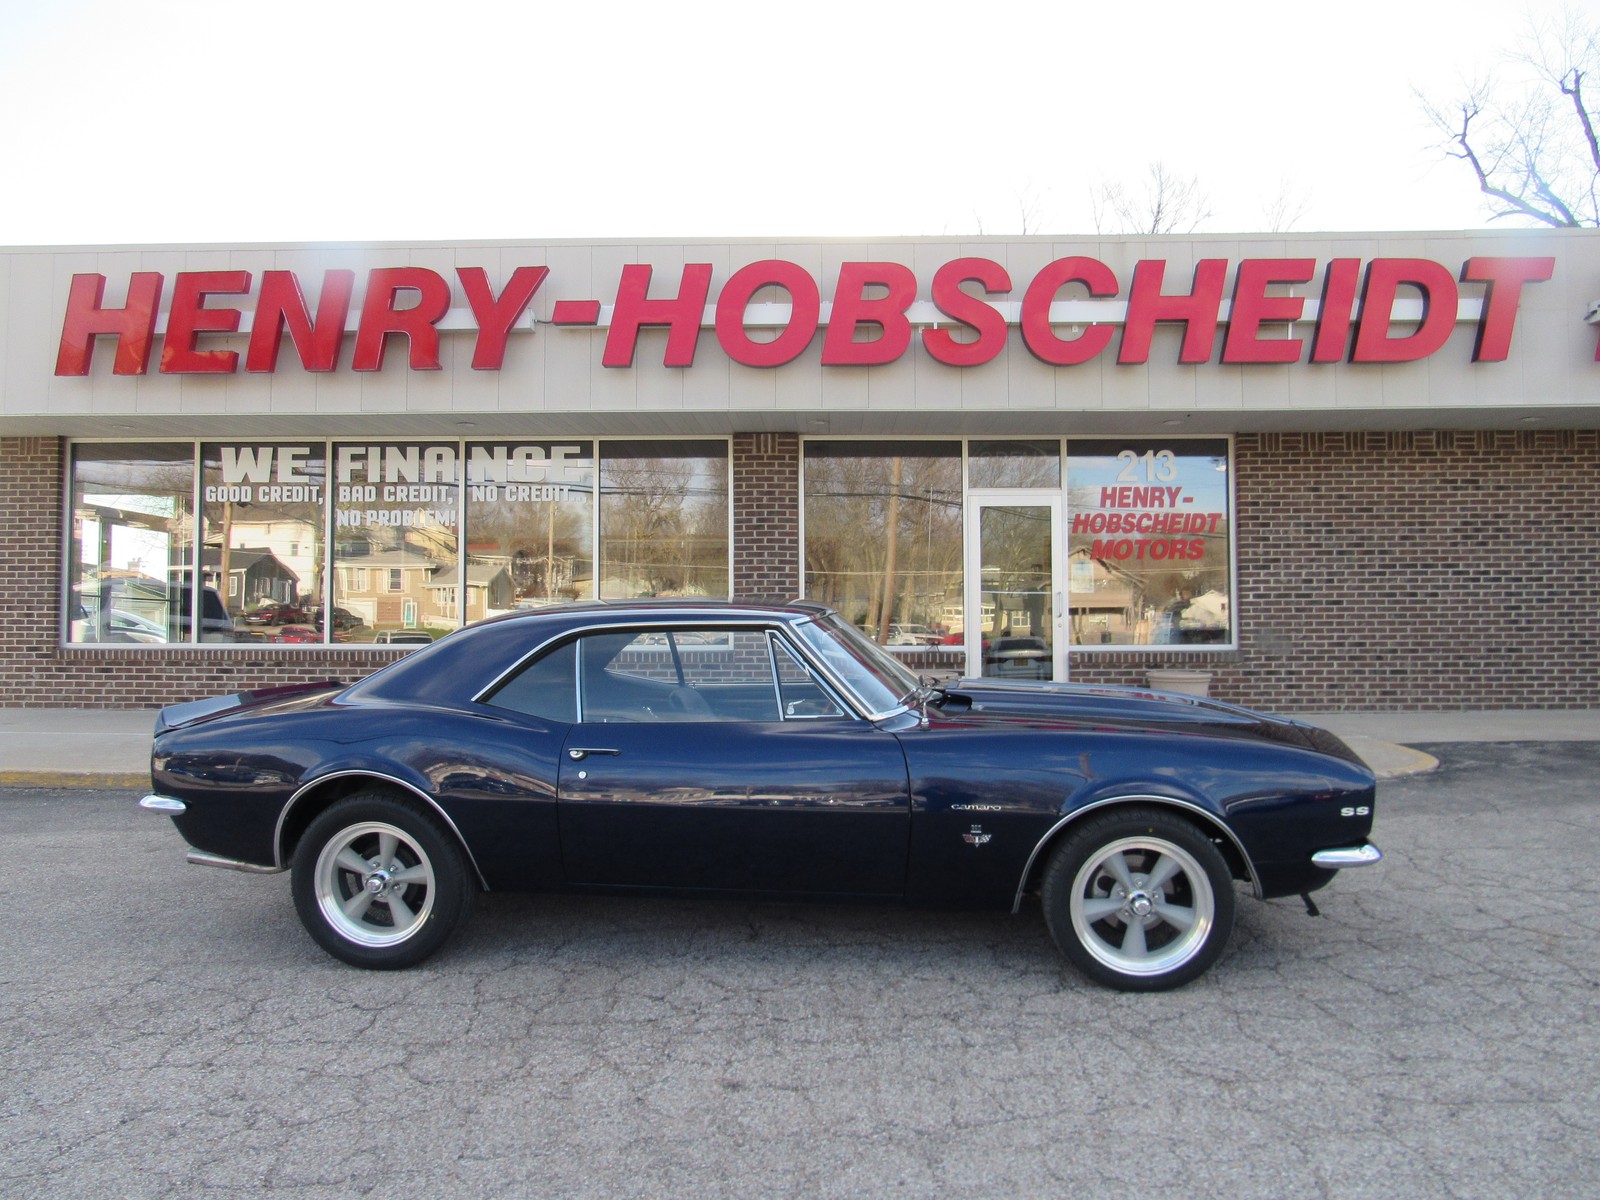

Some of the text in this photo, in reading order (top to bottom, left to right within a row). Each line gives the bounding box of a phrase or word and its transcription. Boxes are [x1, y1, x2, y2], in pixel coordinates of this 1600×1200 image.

[54, 256, 1555, 377] HENRY-HOBSCHEIDT
[221, 446, 581, 483] WE FINANCE
[1116, 449, 1179, 482] 213
[206, 485, 252, 503] GOOD
[258, 485, 324, 505] CREDIT,
[339, 485, 376, 502] BAD
[383, 485, 454, 505] CREDIT,
[472, 485, 498, 502] NO
[1100, 486, 1194, 509] HENRY-
[336, 509, 456, 527] NO PROBLEM!
[1072, 513, 1223, 534] HOBSCHEIDT
[1090, 539, 1206, 560] MOTORS
[1341, 806, 1370, 817] SS
